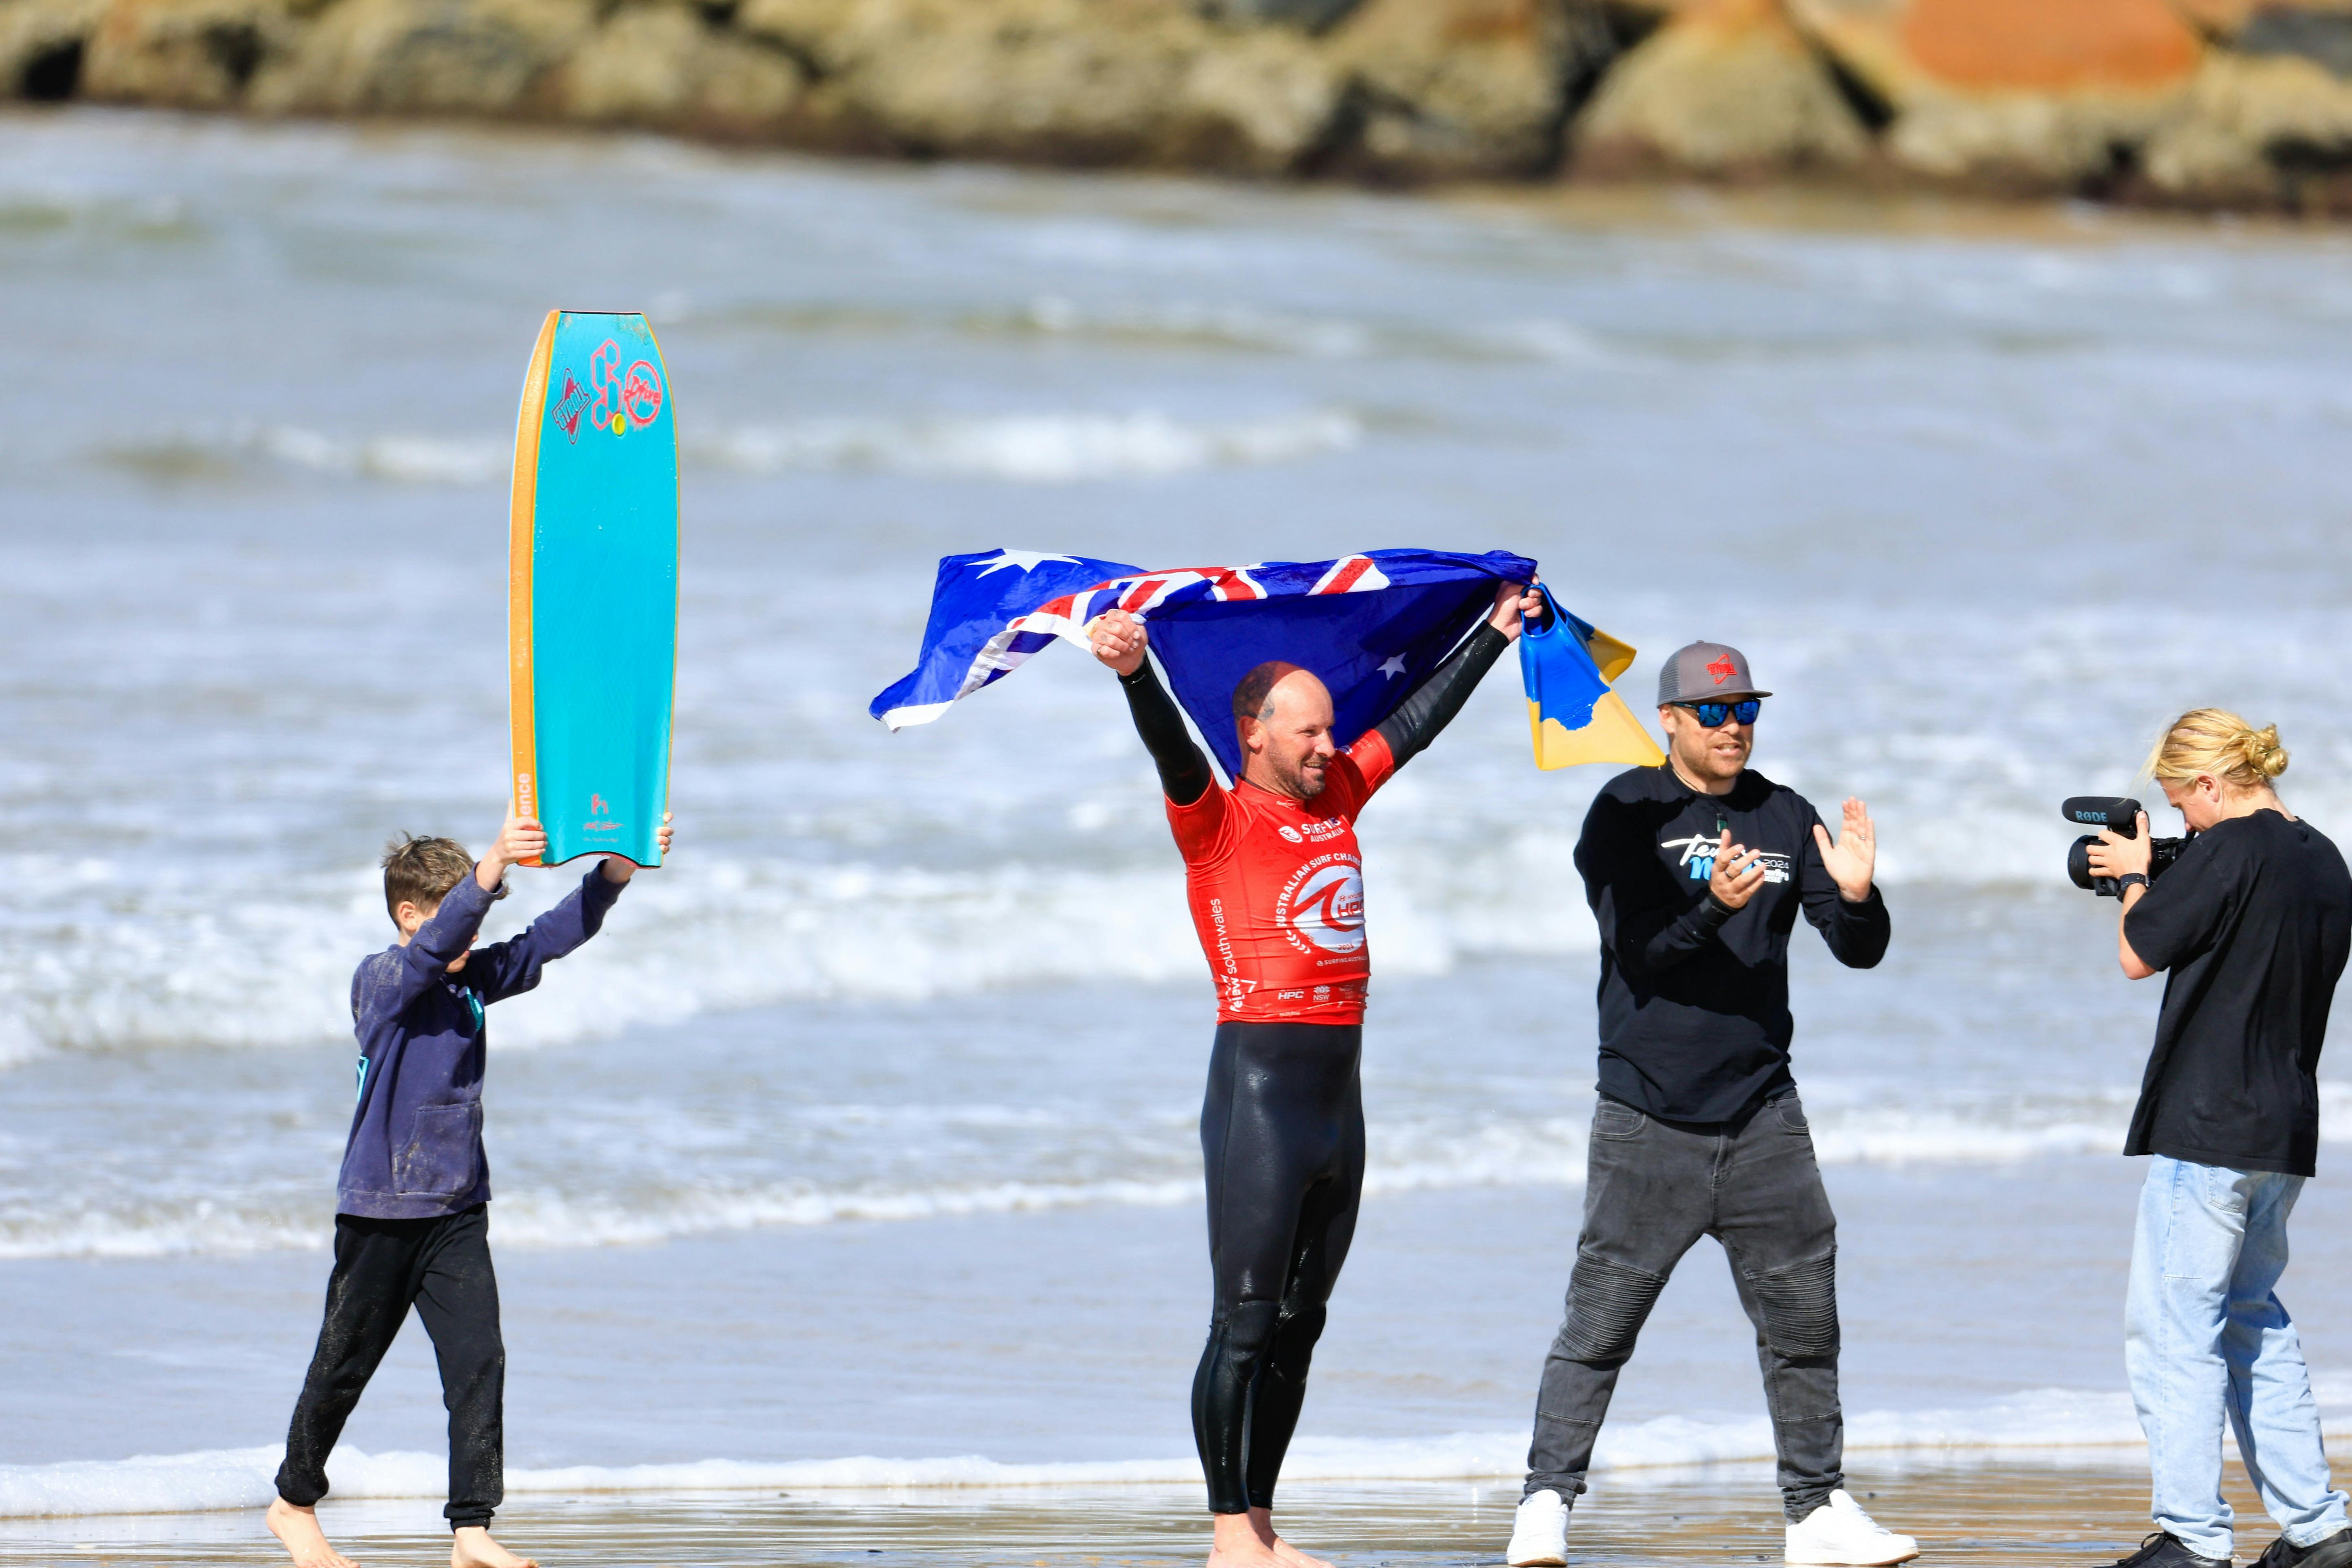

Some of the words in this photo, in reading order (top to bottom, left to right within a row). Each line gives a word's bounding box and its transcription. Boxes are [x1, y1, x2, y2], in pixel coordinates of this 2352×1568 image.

[518, 773, 532, 816] ence
[1310, 827, 1345, 842] AUSTRALIA
[1309, 854, 1332, 868] SURF
[1763, 859, 1789, 869] 2024
[1210, 898, 1226, 936] wales
[1217, 937, 1238, 974] south
[1278, 991, 1304, 1000] HPC
